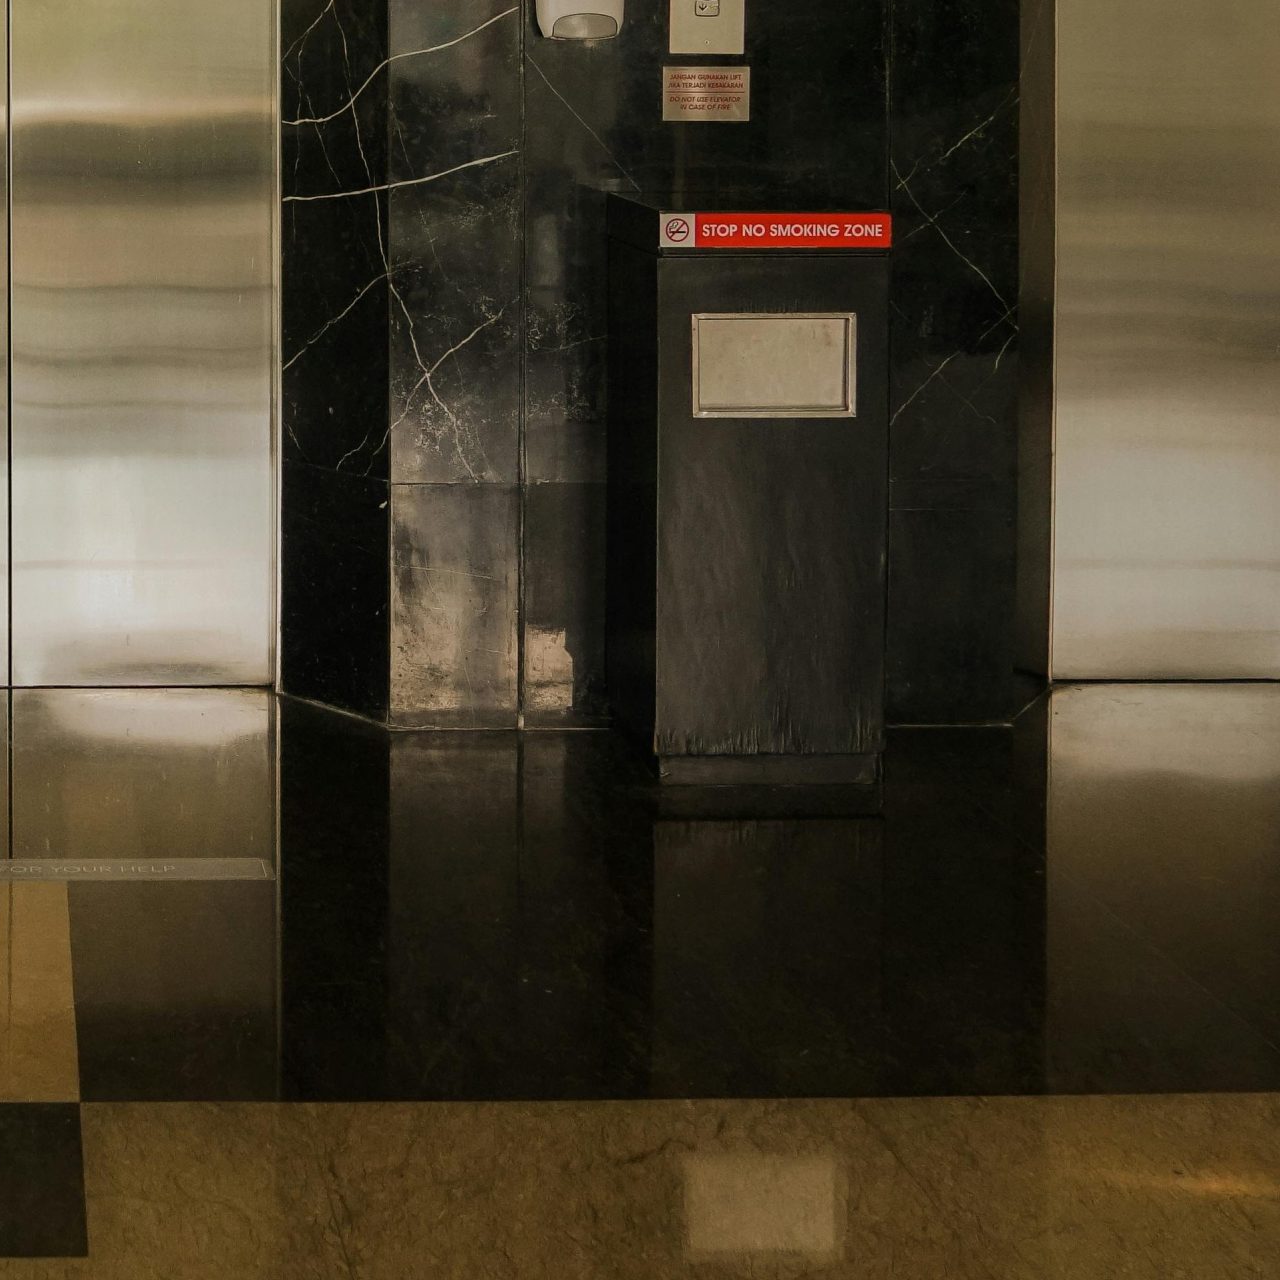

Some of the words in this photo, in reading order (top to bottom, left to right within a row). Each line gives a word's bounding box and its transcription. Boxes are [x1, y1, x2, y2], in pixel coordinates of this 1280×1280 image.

[701, 223, 738, 237] STOP
[742, 223, 766, 237] NO
[769, 223, 840, 237] SMOKING
[843, 223, 883, 238] ZONE
[51, 865, 112, 874] YOUR
[120, 865, 177, 874] HELP
